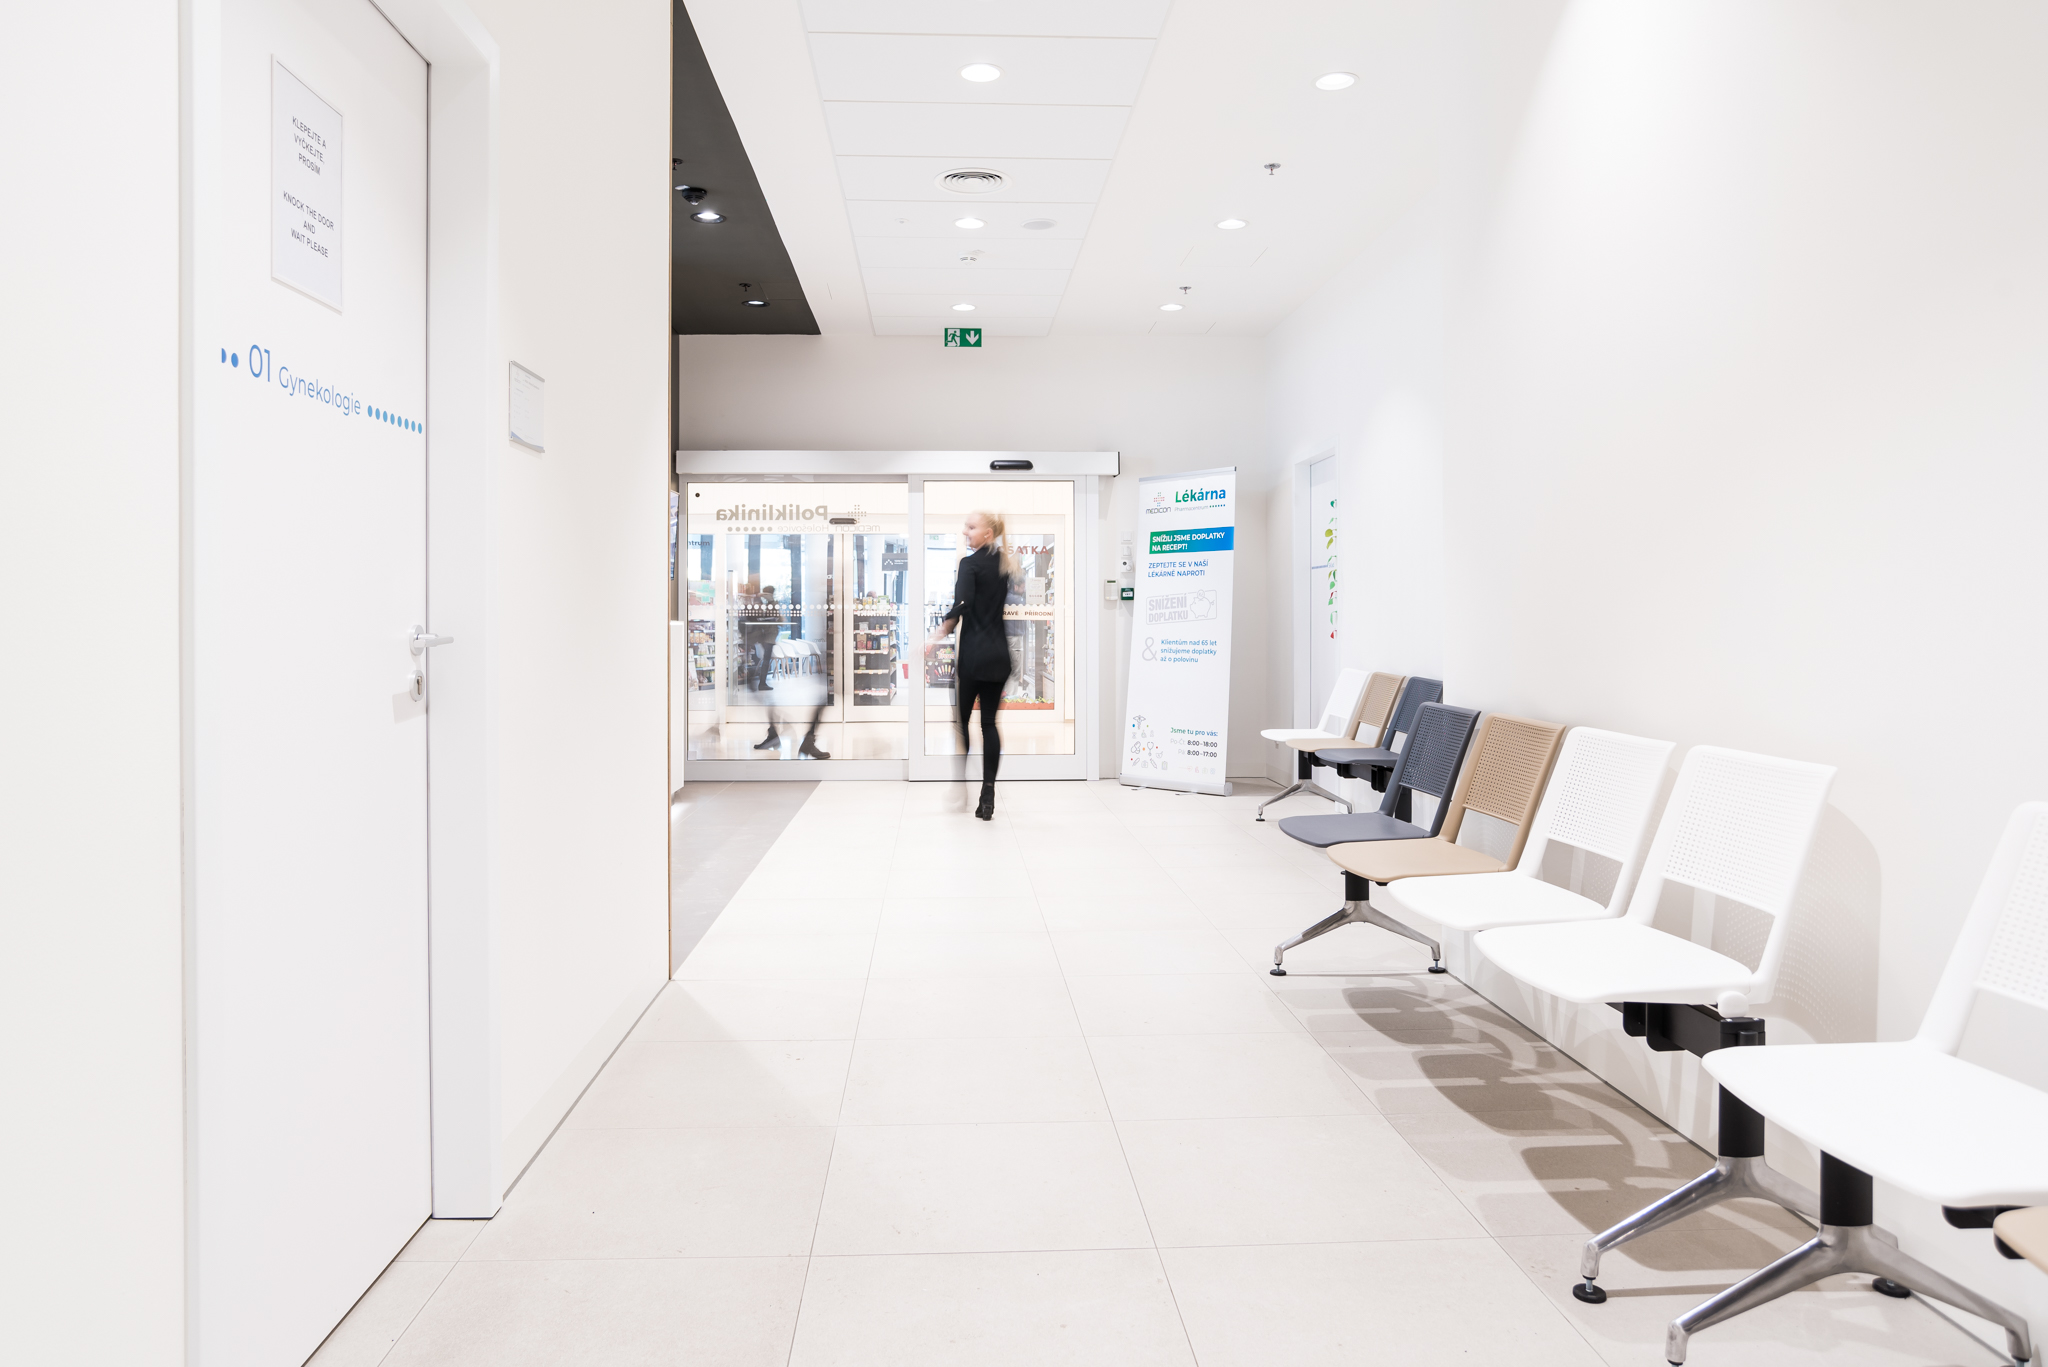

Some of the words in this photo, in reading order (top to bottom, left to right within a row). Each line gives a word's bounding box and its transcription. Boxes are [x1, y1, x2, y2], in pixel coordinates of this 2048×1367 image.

[292, 116, 321, 145] KLEPEJTE
[322, 140, 327, 149] A
[298, 152, 321, 176] PROSÍM
[283, 190, 305, 212] KNOCK
[306, 205, 317, 220] THE
[318, 213, 334, 231] DOOR
[303, 220, 316, 234] AND
[291, 227, 306, 244] WAIT
[307, 237, 329, 258] PLEASE
[249, 344, 271, 382] 01
[279, 366, 361, 416] Gynekologie
[1175, 488, 1226, 503] Lékárna
[1152, 533, 1173, 543] SNÍŽILI
[1173, 533, 1191, 542] JSME
[1192, 531, 1225, 540] DOPLATKY
[1151, 544, 1161, 552] NA
[1162, 543, 1188, 551] RECEPT!
[1148, 561, 1177, 569] ZEPTEJTE
[1193, 559, 1209, 567] NAŠÍ
[1148, 569, 1176, 578] LÉKÁRNĚ
[1176, 569, 1206, 577] NAPROTI
[1148, 592, 1188, 611] SNÍŽENÍ
[1024, 609, 1054, 617] PŘÍRODNÍ
[1148, 610, 1189, 623] DOPLATKU
[1191, 648, 1217, 656] doplatky
[1170, 727, 1186, 735] Jsme
